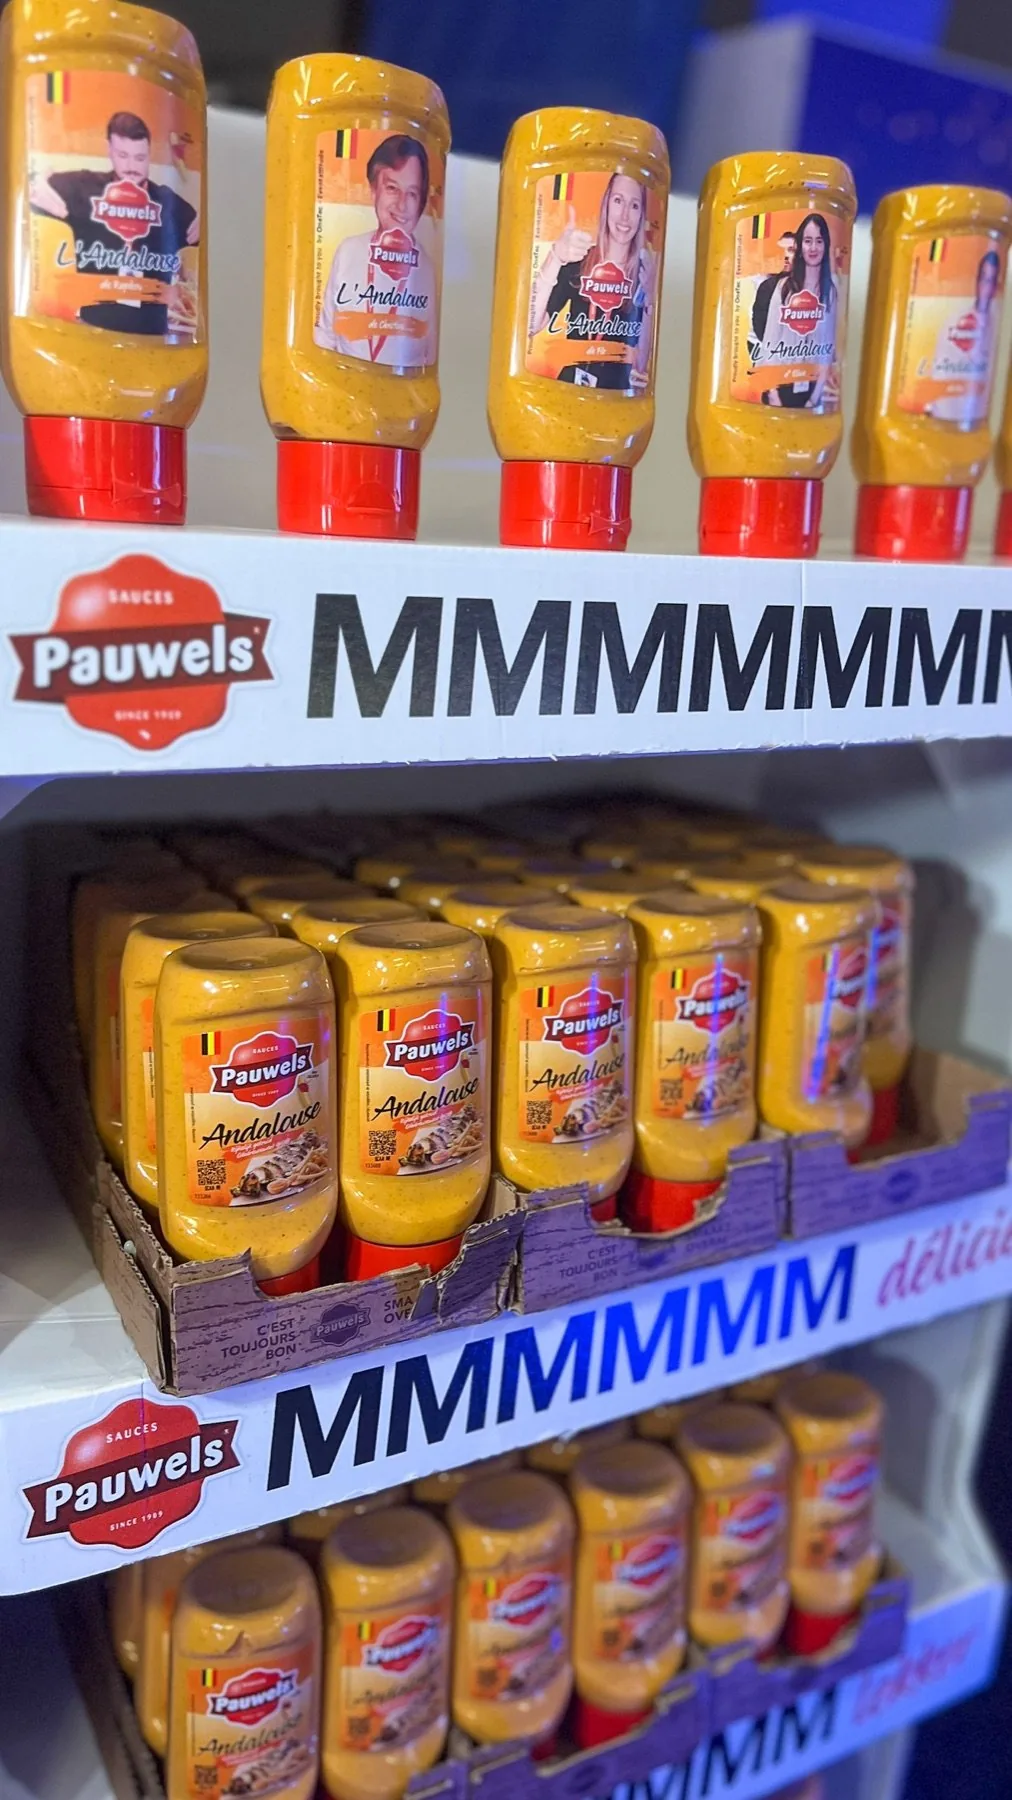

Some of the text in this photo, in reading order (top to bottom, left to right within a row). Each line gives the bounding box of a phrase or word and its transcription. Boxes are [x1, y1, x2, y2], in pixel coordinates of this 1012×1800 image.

[98, 201, 157, 221] Pauwels
[56, 240, 181, 271] L'Andalouse
[374, 247, 417, 265] Pauwels
[336, 283, 428, 309] L'Andalouse
[585, 280, 629, 295] Pauwels
[314, 301, 322, 328] Proudly
[548, 312, 642, 336] L'Andalouse
[784, 308, 822, 320] Pauwels
[108, 588, 174, 606] SAUCES
[33, 623, 254, 689] Pauwels
[551, 1007, 619, 1036] Pauwels
[394, 1030, 469, 1062] Pauwels
[221, 1053, 307, 1088] Pauwels
[371, 1077, 479, 1121] Andalouse
[199, 1101, 321, 1150] Andalouse
[587, 1244, 617, 1260] C'EST
[560, 1255, 618, 1279] TOUJOURS
[257, 1318, 296, 1336] C'EST
[315, 1312, 365, 1337] Pauwels
[221, 1331, 296, 1359] TOUJOURS
[265, 1344, 297, 1361] BON
[266, 1242, 858, 1492] MMMMMM
[106, 1421, 158, 1445] SAUCES
[45, 1435, 223, 1523] Pauwels
[109, 1517, 138, 1532] SINCE
[215, 1680, 294, 1712] Pauwels
